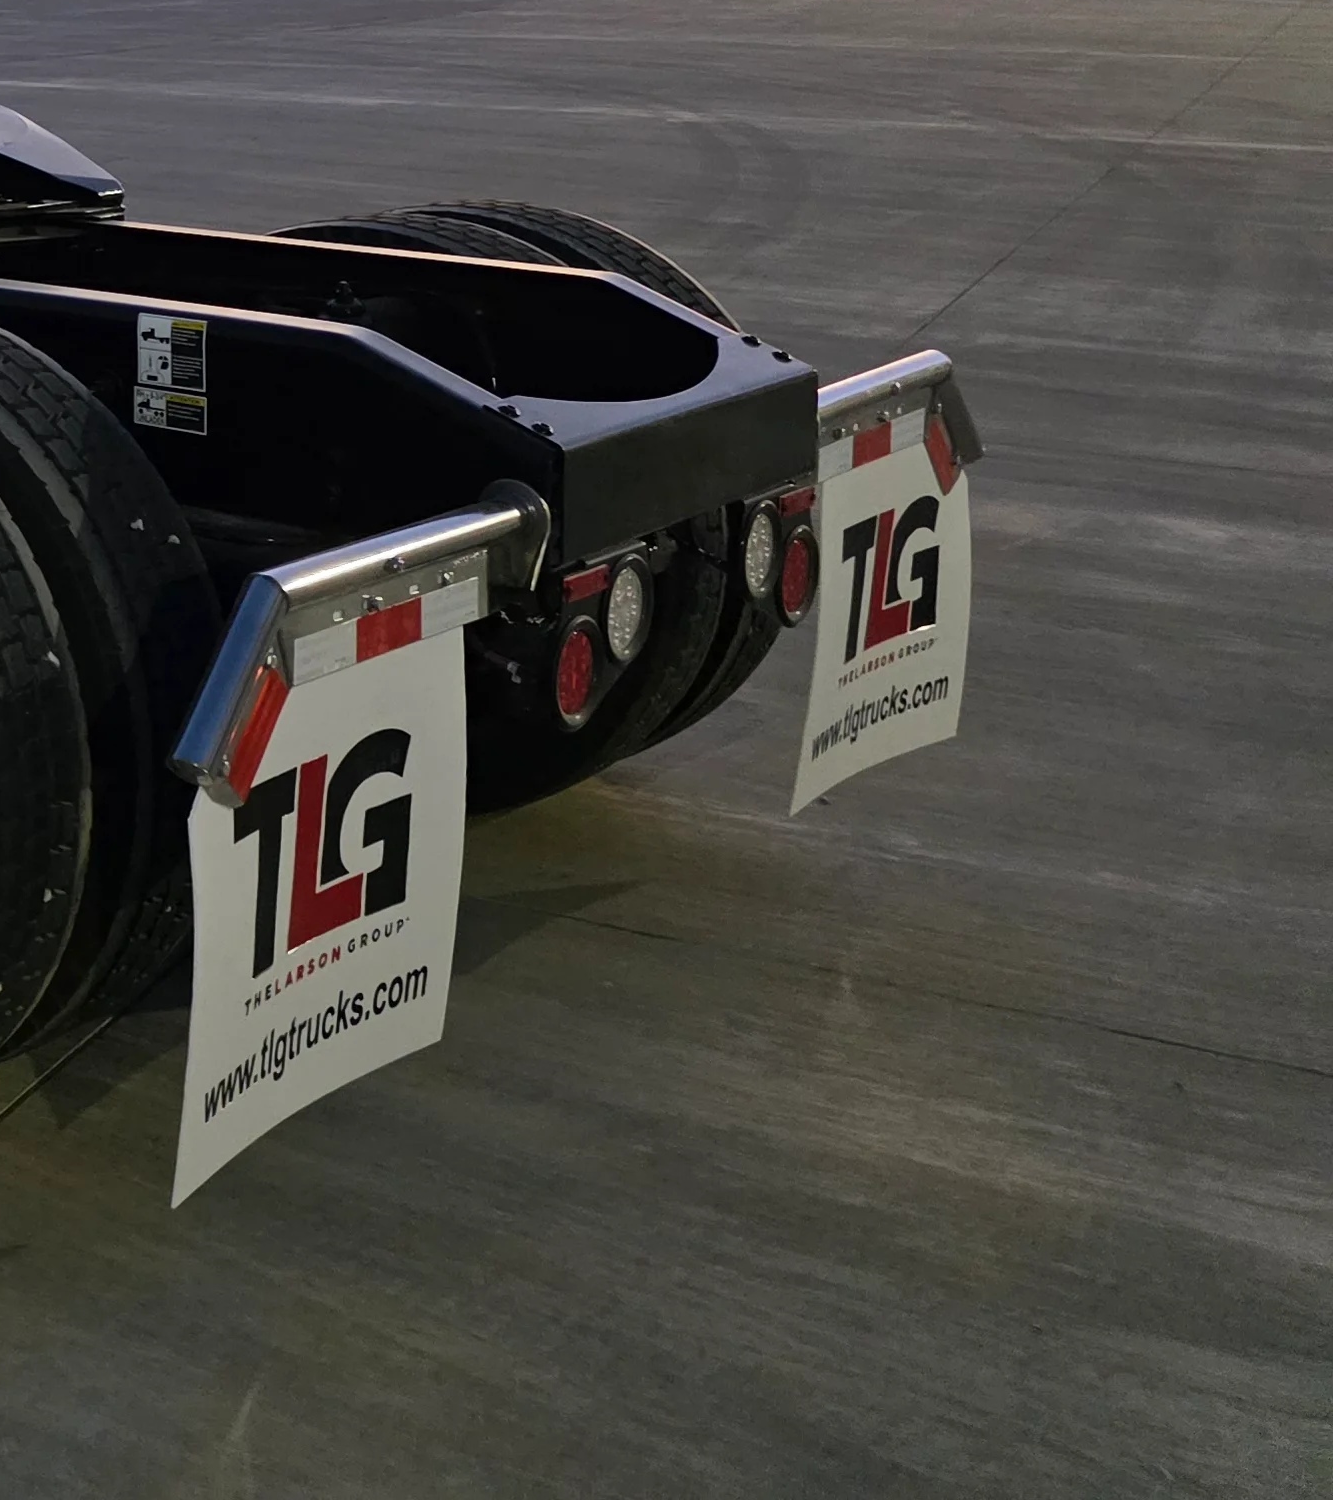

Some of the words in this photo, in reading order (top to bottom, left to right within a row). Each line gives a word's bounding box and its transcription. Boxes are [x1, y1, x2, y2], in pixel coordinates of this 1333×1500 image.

[842, 495, 941, 665] TLG
[897, 637, 935, 660] GROUP
[811, 675, 949, 762] www.tlgtrucks.com
[233, 728, 412, 979] TLG
[274, 946, 341, 995] LARSON
[347, 920, 406, 954] GROUP
[203, 965, 429, 1123] www.tlgtrucks.com
